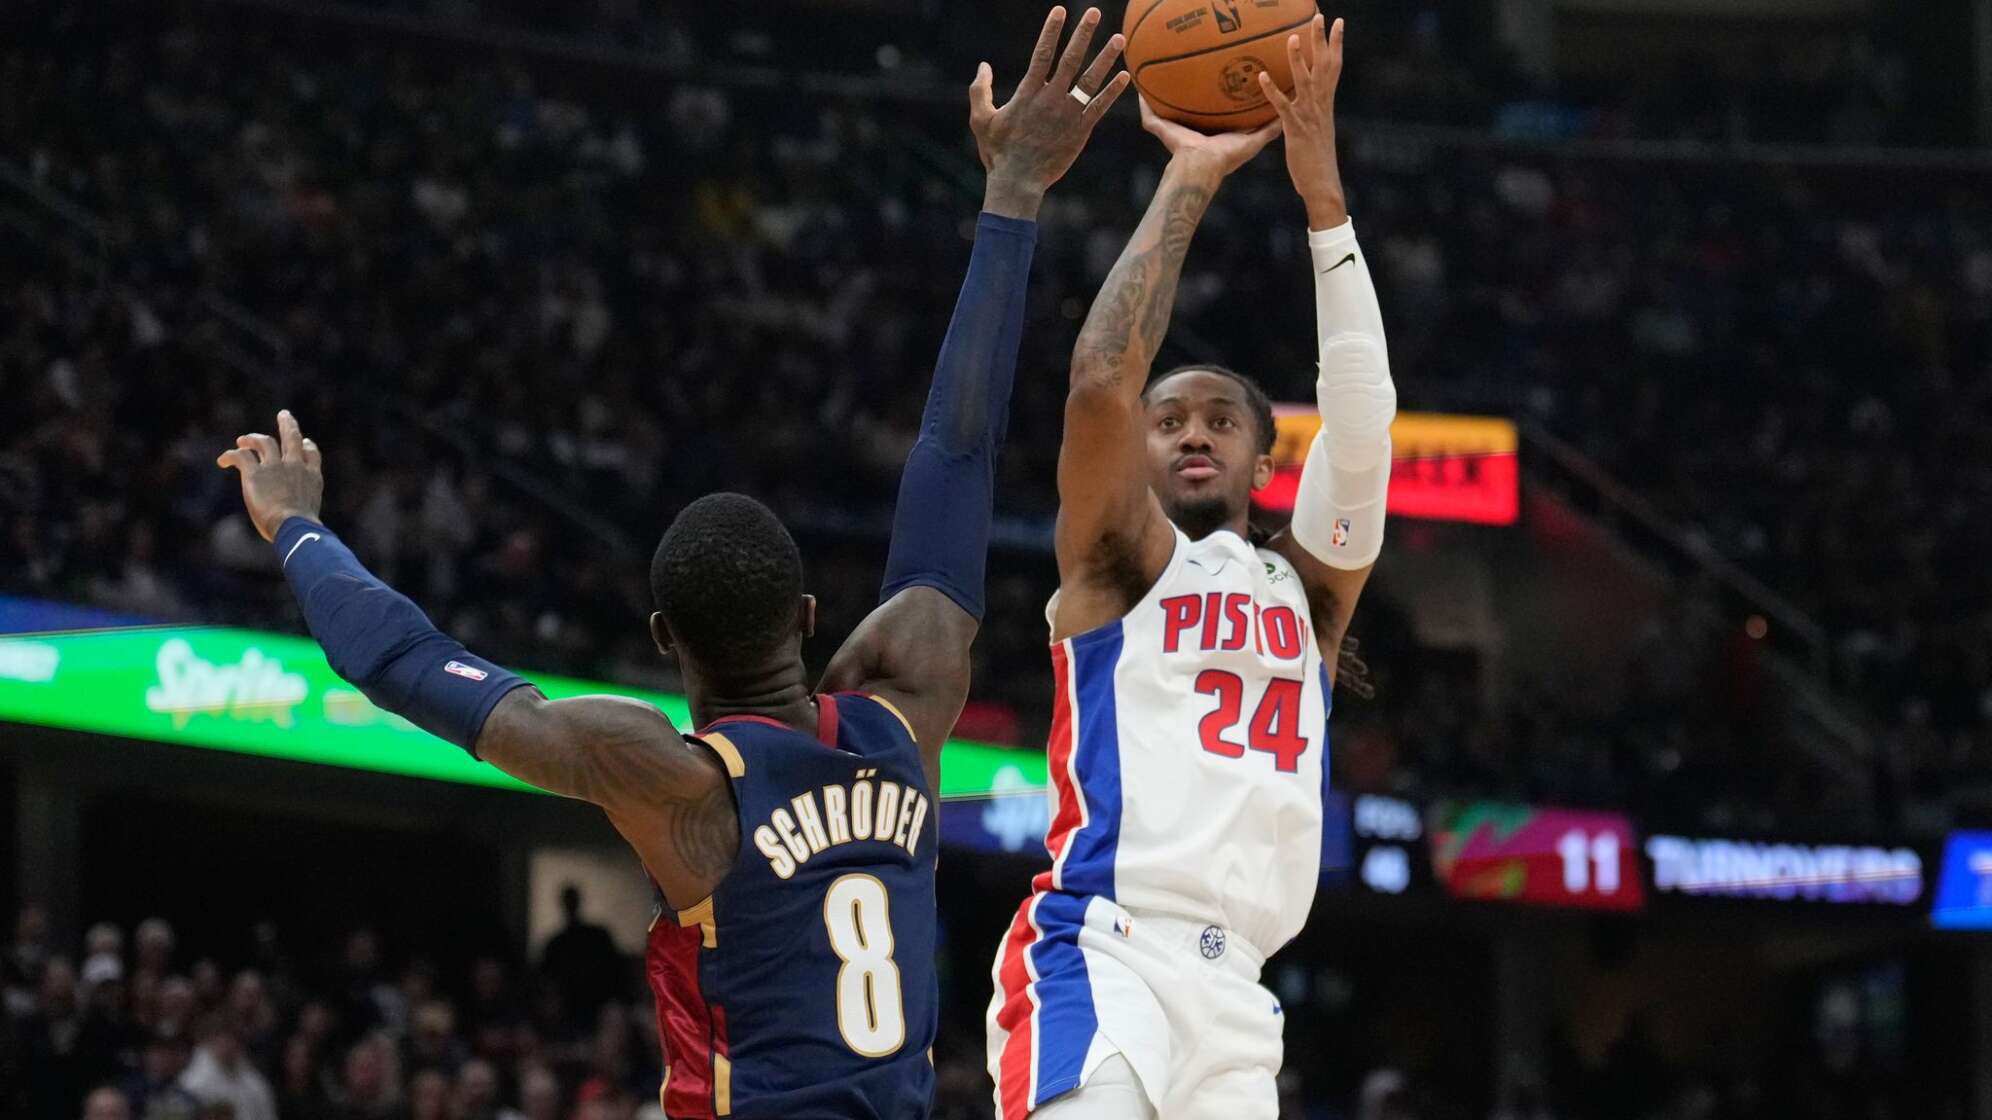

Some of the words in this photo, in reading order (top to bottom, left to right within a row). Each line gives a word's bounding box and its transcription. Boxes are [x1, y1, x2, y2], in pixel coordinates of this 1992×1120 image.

[1159, 592, 1308, 660] PISO
[1194, 668, 1308, 774] 24
[754, 768, 928, 880] SCHRÖDER
[1558, 829, 1621, 894] 11
[824, 873, 906, 1058] 8
